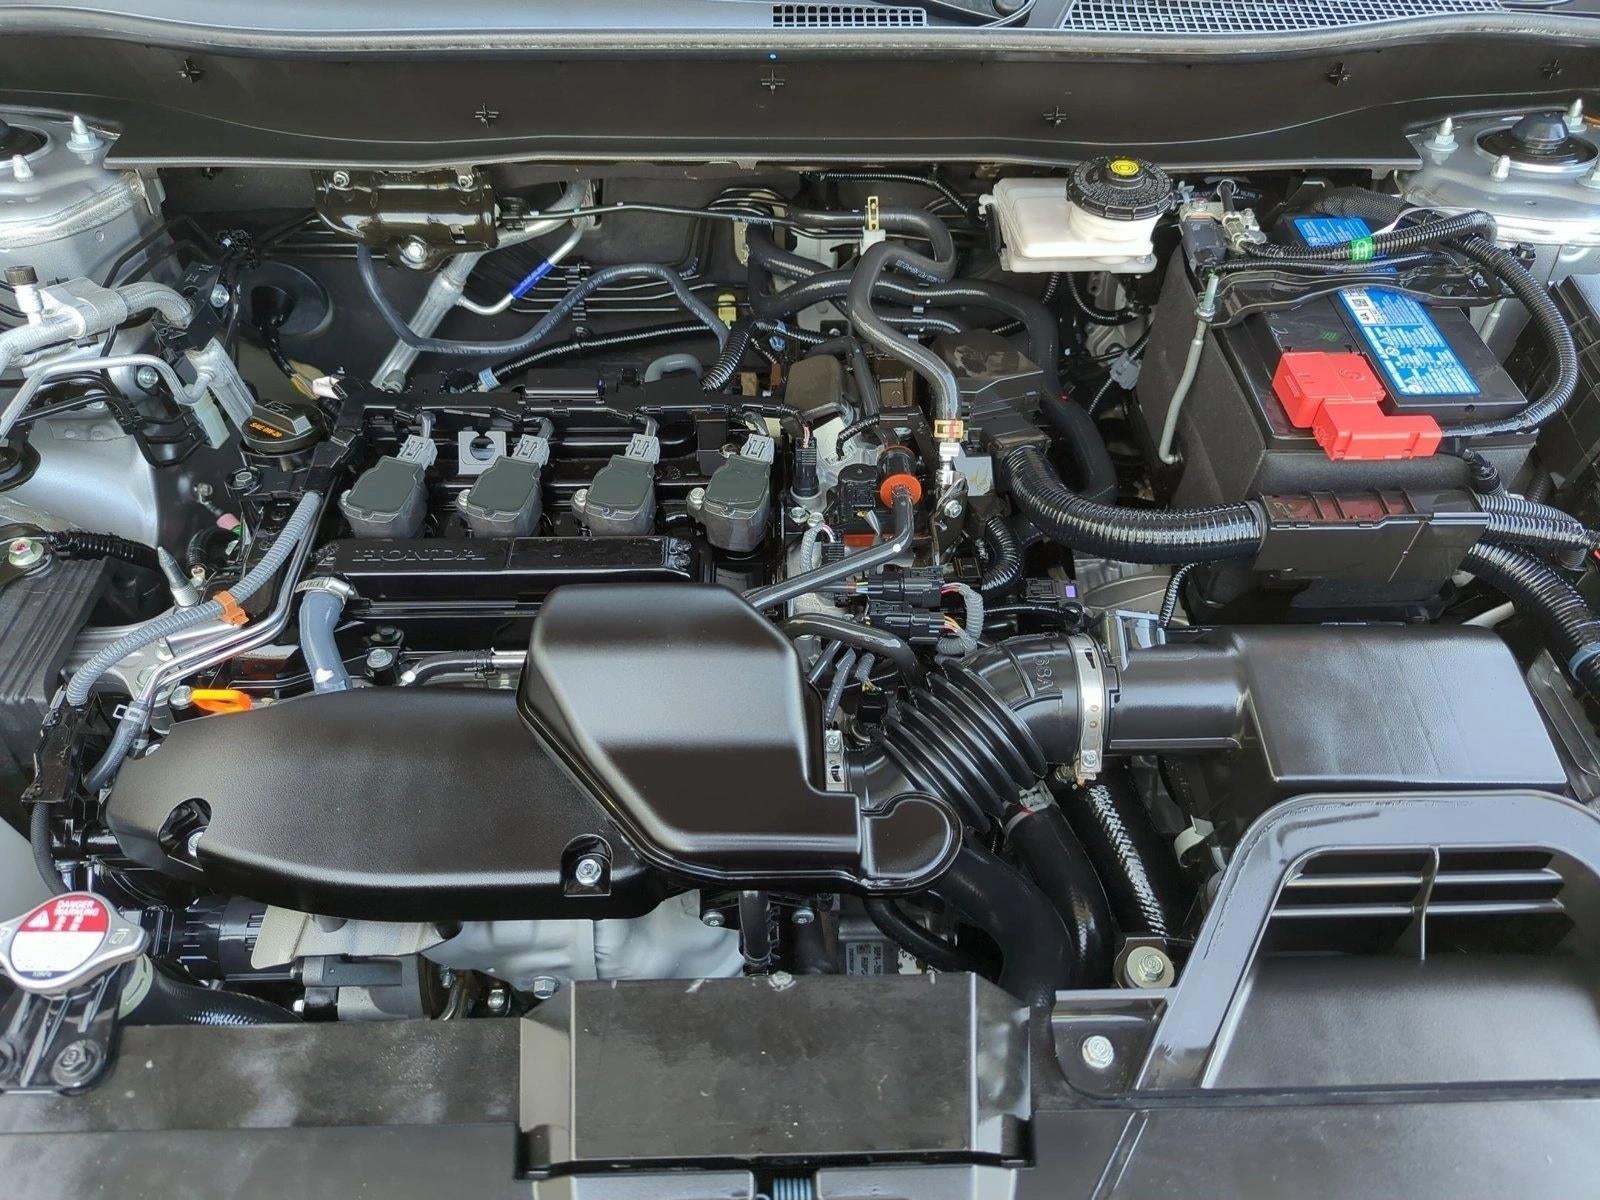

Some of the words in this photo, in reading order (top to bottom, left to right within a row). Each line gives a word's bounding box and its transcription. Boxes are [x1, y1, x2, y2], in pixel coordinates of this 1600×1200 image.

[352, 549, 486, 561] HONDA
[57, 900, 95, 909] DANGER
[54, 908, 100, 917] WARNING
